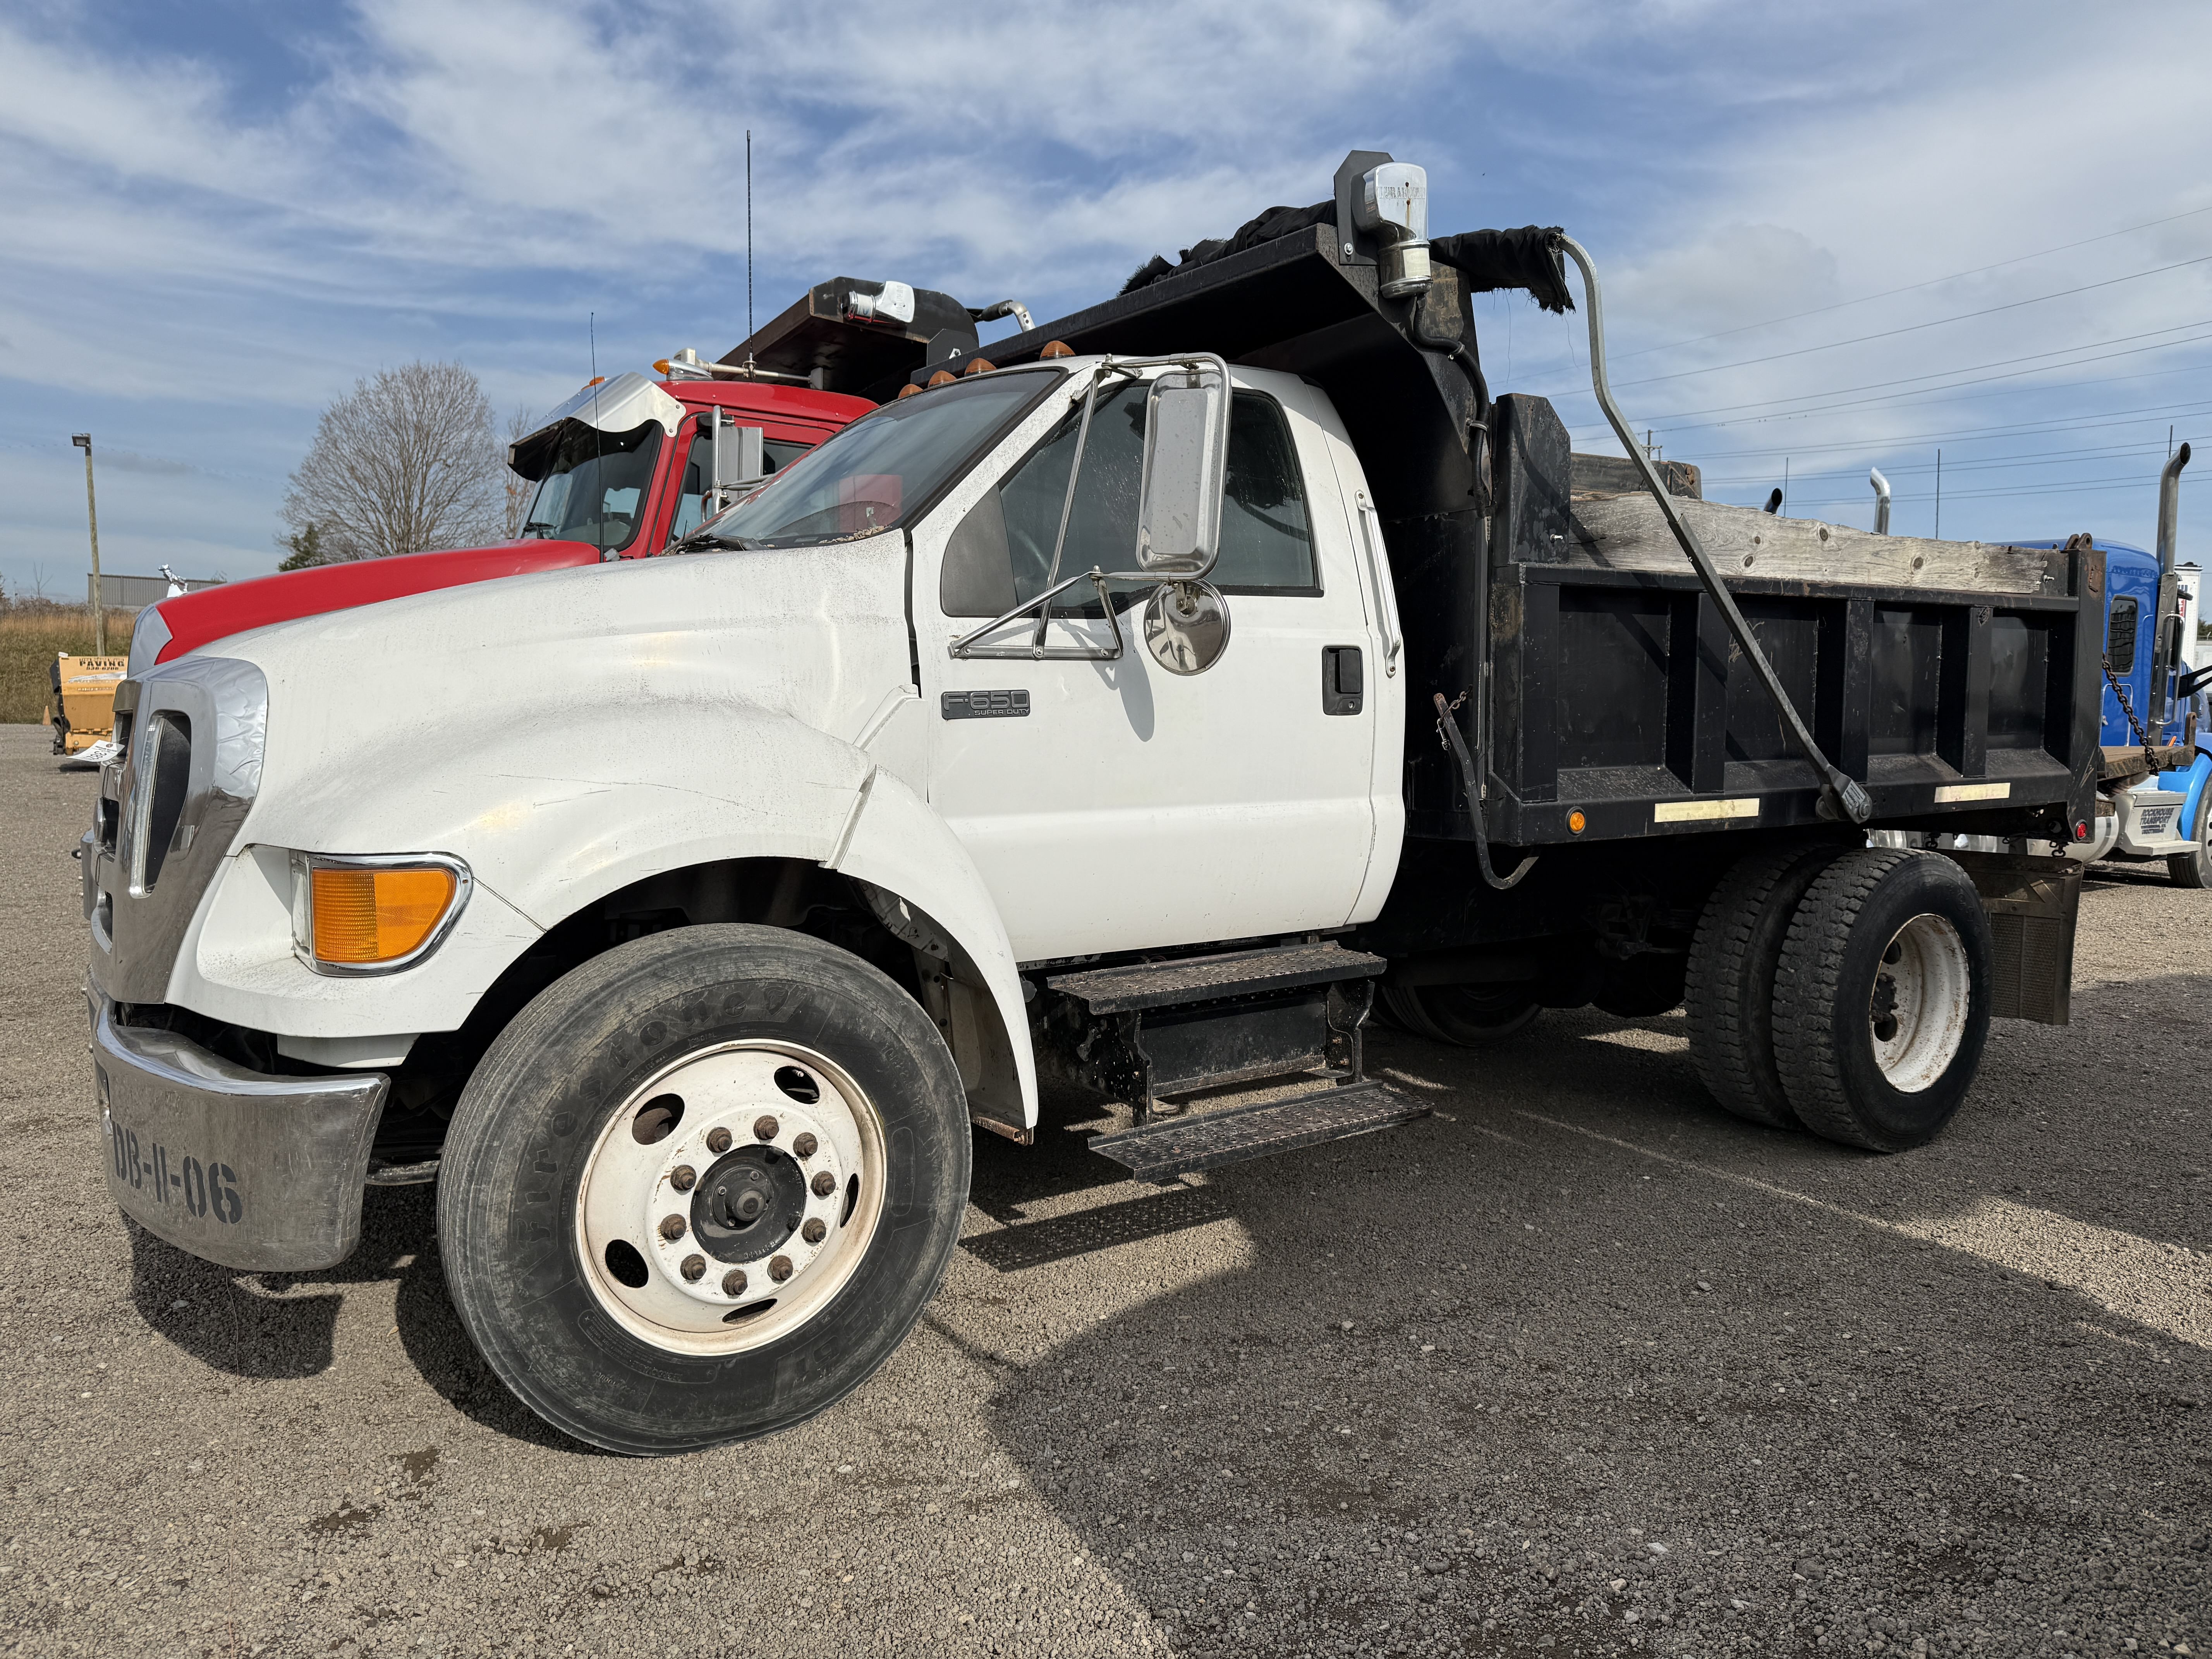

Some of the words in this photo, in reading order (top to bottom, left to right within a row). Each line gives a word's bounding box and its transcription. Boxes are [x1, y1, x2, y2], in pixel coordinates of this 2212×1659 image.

[943, 690, 1029, 710] F-650
[2141, 808, 2174, 817] ROCKHOUSE
[2140, 816, 2171, 825] TRANSPORT
[516, 991, 747, 1244] Firestone
